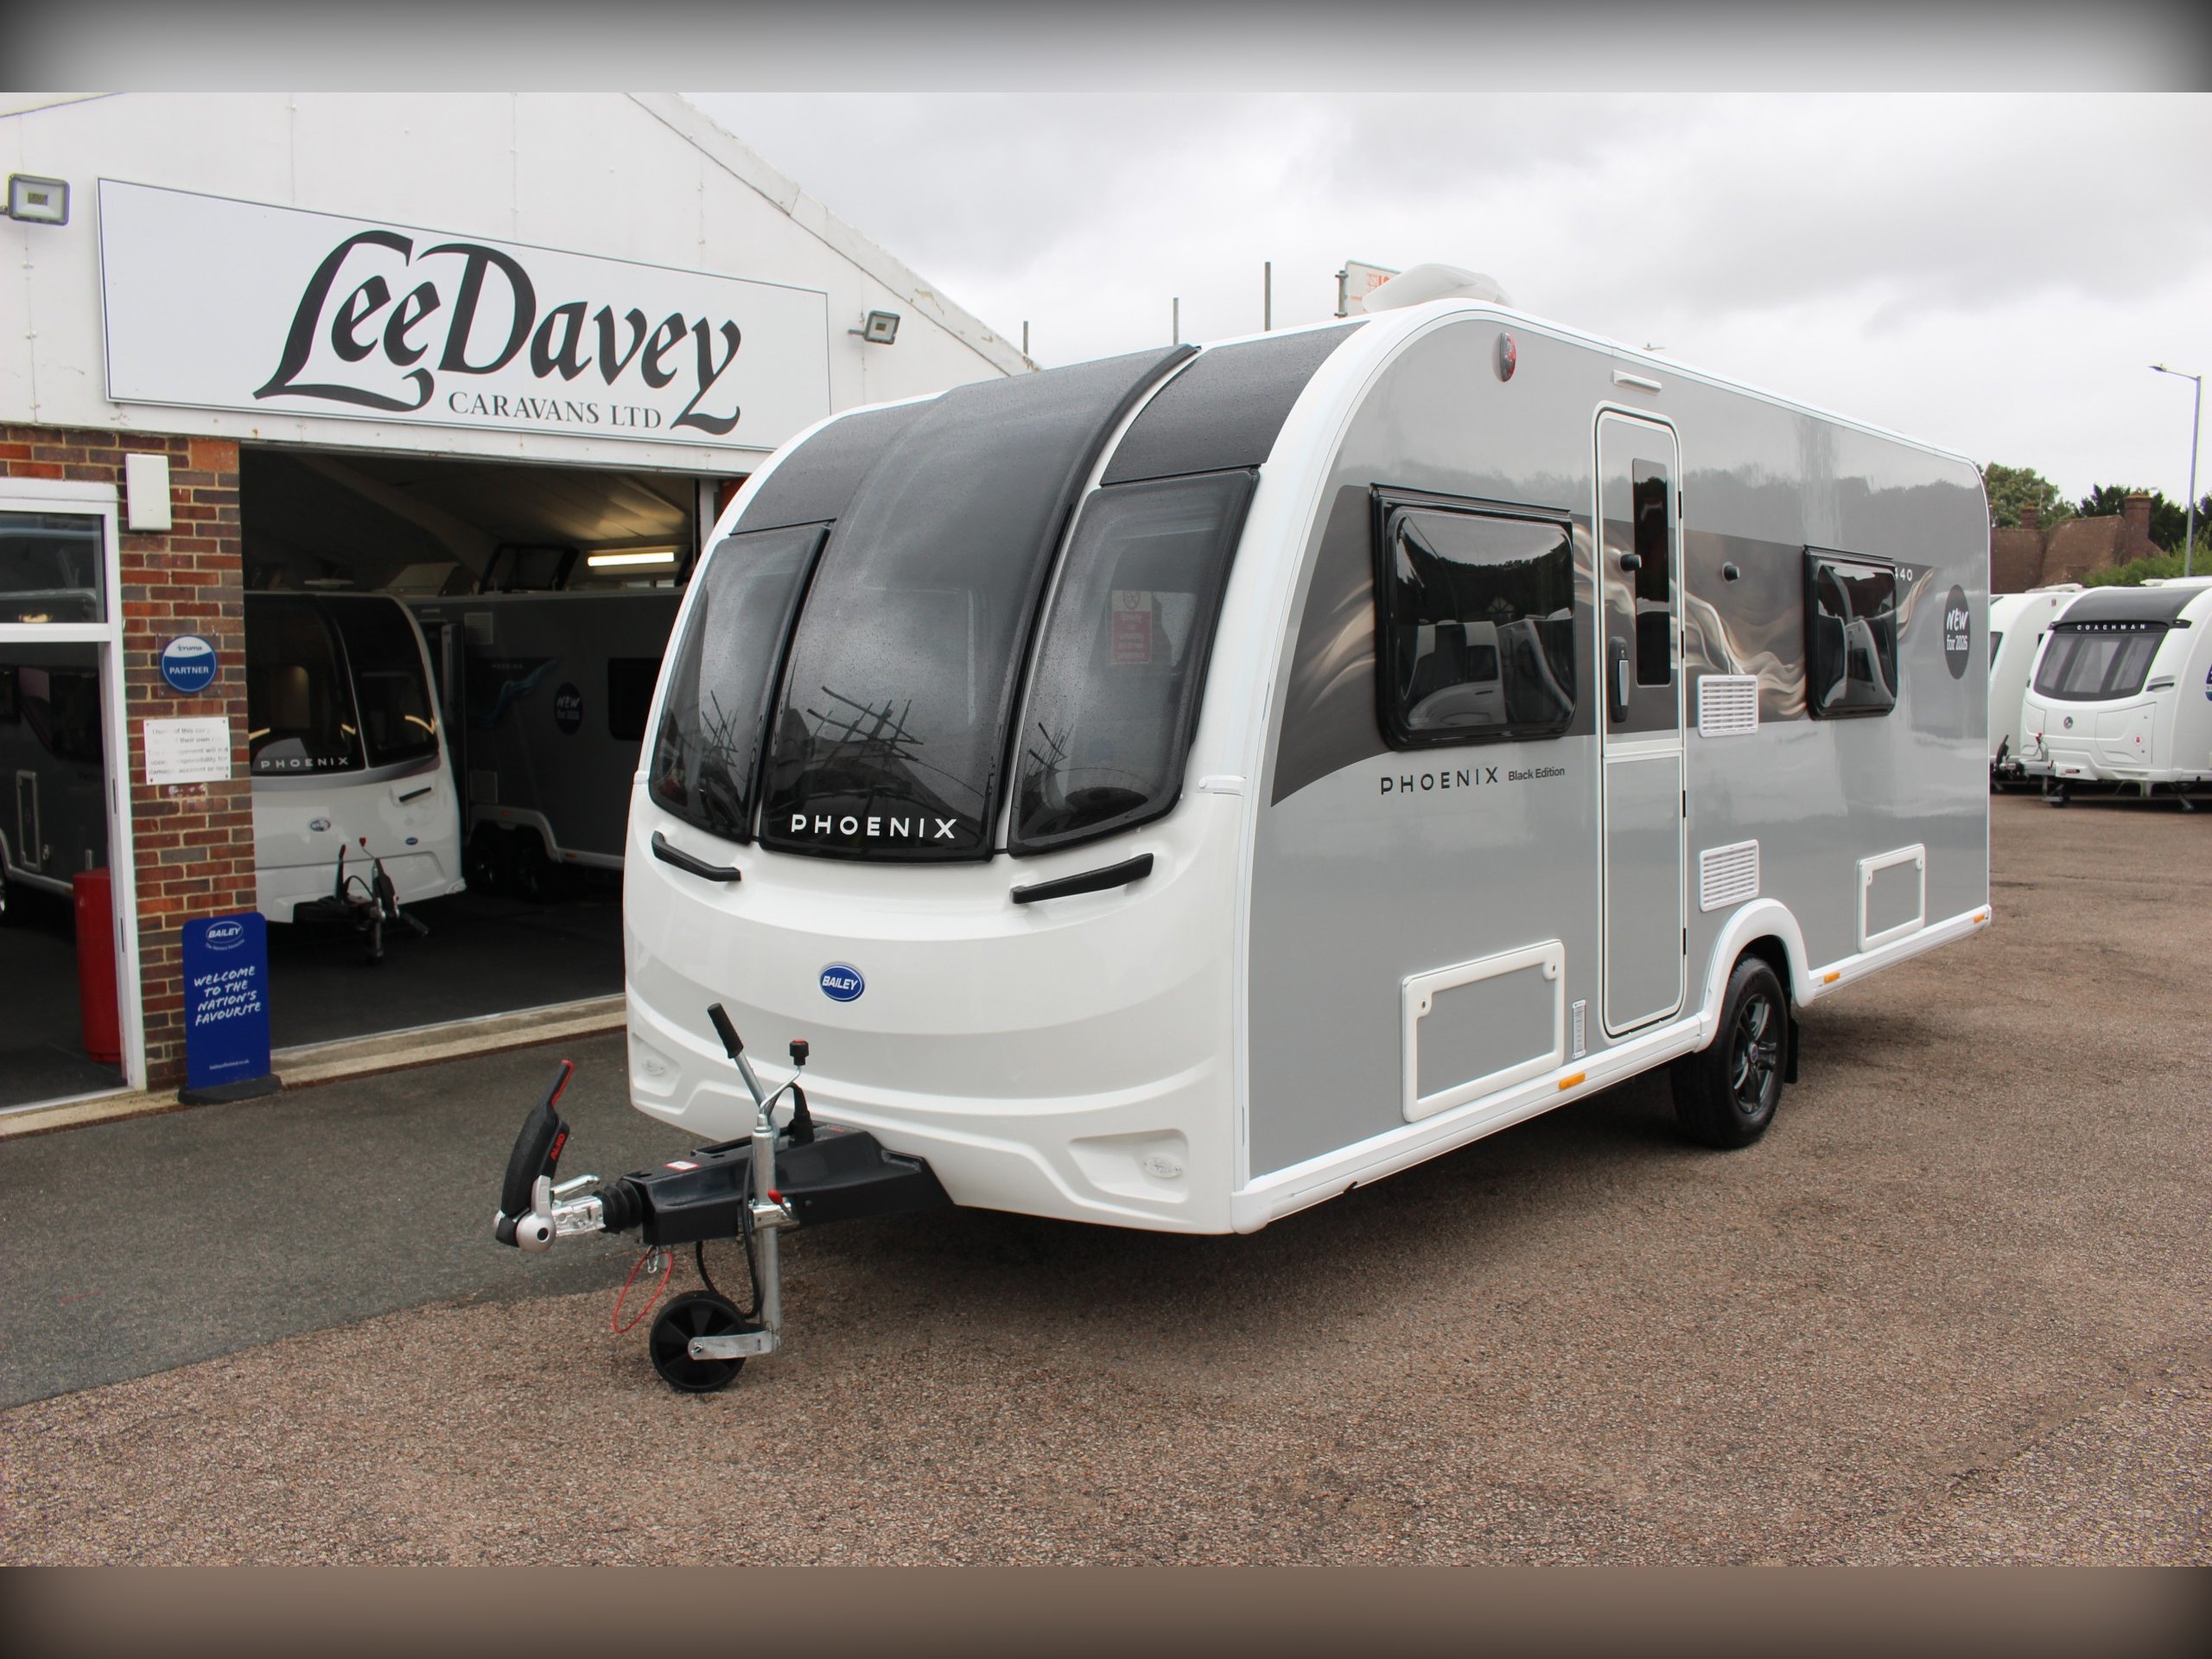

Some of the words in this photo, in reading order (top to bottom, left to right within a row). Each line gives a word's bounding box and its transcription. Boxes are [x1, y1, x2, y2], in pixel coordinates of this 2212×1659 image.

[448, 391, 600, 424] CARAVANS
[609, 404, 662, 429] LTD
[1946, 608, 1968, 631] NEW
[261, 756, 349, 769] PHOENIX
[1381, 766, 1498, 795] PHOENIX
[1508, 770, 1534, 781] Black
[1535, 766, 1565, 779] Edition
[791, 814, 957, 839] PHOENIX
[208, 927, 241, 938] BAILEY
[194, 965, 255, 987] WELCOME
[822, 976, 859, 990] BAILEY
[204, 986, 221, 997] TO
[224, 980, 248, 993] THE
[197, 990, 257, 1012] NATION'S
[194, 1001, 261, 1027] FAVOURITE
